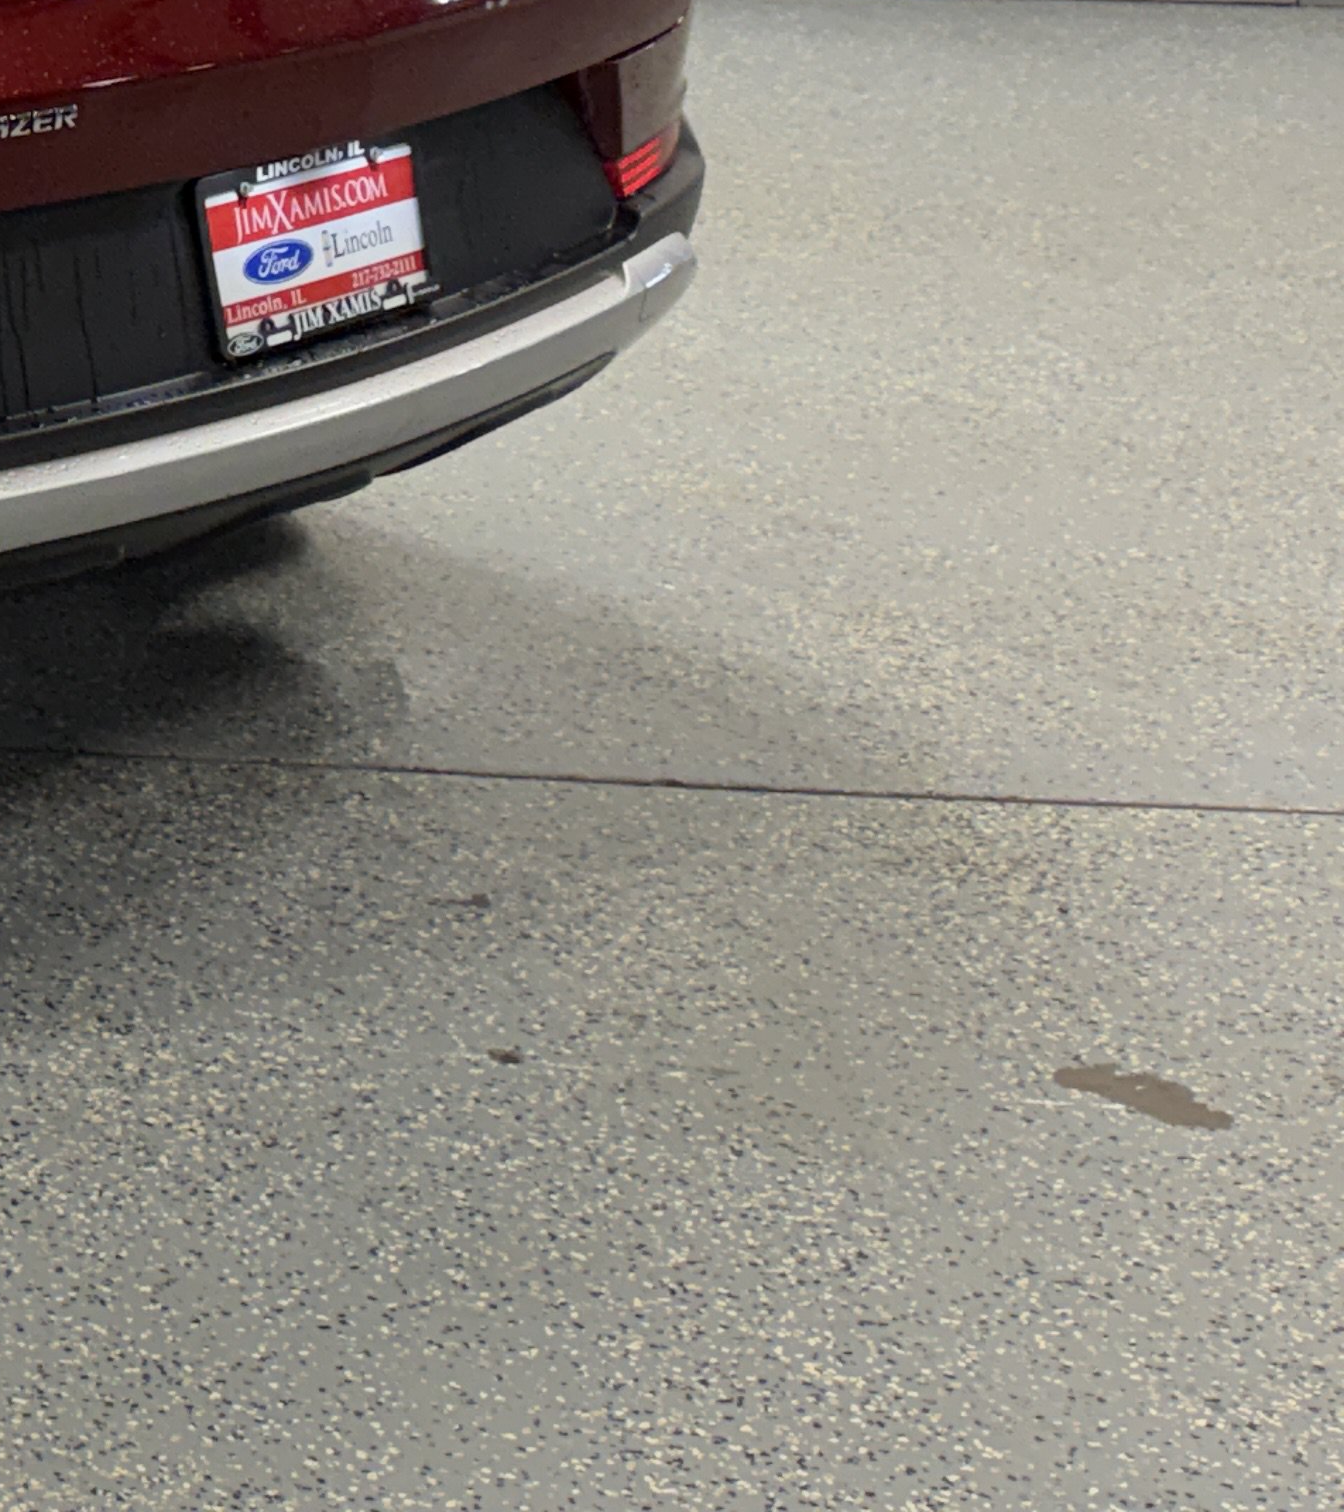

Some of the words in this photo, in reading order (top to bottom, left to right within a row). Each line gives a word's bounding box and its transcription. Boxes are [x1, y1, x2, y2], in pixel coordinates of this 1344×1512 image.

[256, 145, 344, 182] LINCOLN,
[347, 140, 365, 157] IL
[233, 173, 388, 244] JIMXAMIS.COM
[331, 221, 394, 259] Lincoln
[258, 247, 301, 278] Ford
[291, 289, 307, 305] IL
[293, 306, 325, 341] JIM
[326, 289, 382, 321] XAMIS
